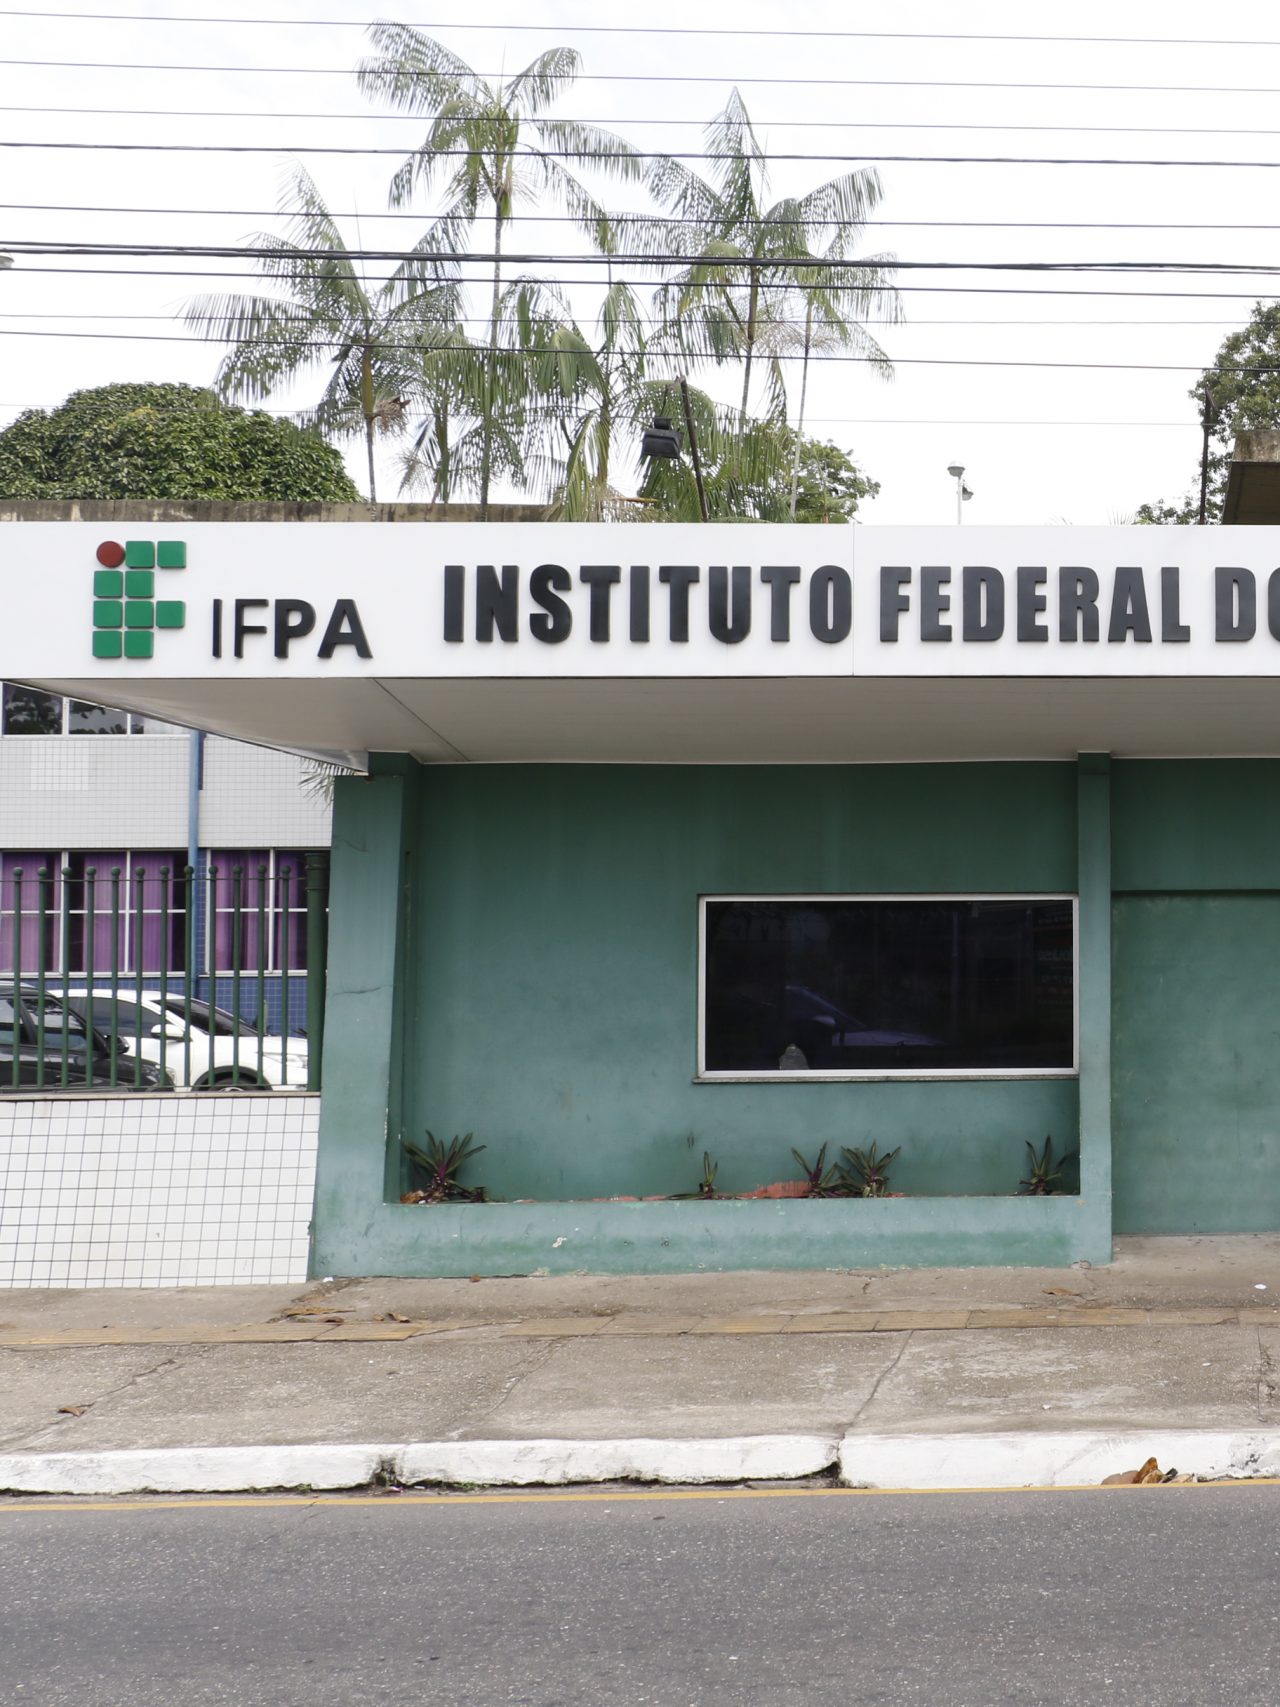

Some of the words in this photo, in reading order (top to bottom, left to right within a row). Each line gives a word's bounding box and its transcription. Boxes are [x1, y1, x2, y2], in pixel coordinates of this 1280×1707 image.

[212, 598, 374, 659] IFPA
[443, 565, 852, 645] INSTITUTO
[879, 566, 1191, 644] FEDERAL
